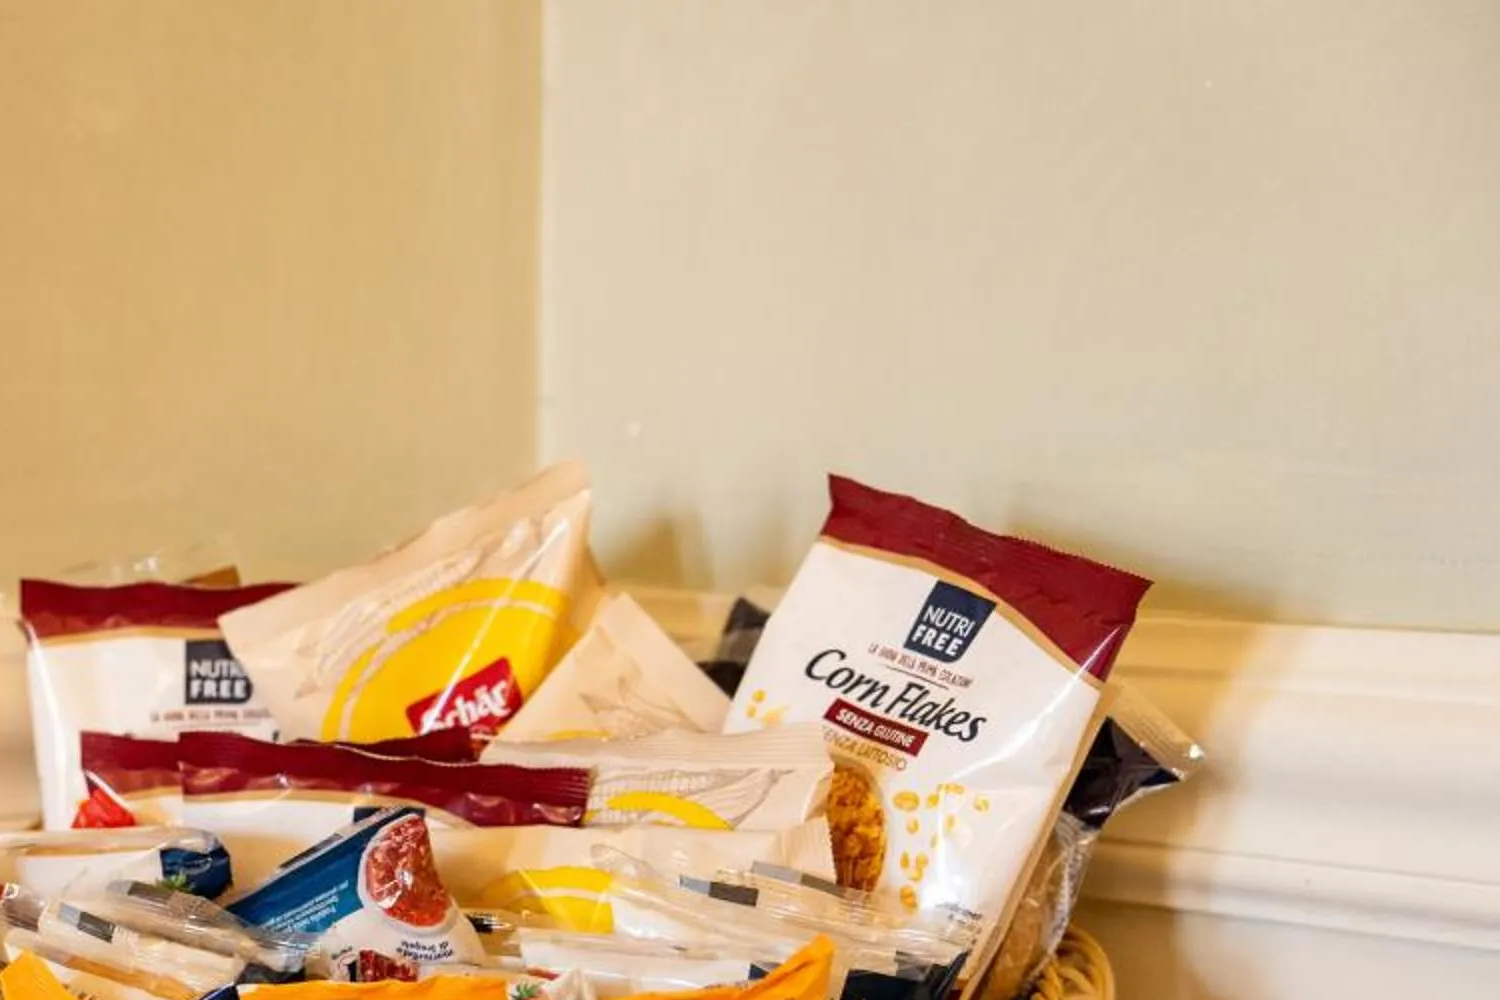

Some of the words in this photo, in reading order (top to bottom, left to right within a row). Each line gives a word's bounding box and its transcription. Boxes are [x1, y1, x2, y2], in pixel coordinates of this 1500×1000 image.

[923, 605, 975, 637] NUTRI
[912, 625, 962, 657] FREE
[190, 659, 247, 679] NUTR
[190, 679, 247, 699] FREE
[805, 648, 890, 709] Corn
[884, 681, 987, 743] Flakes
[835, 708, 872, 734] SENZA
[873, 723, 918, 748] GLUTINE
